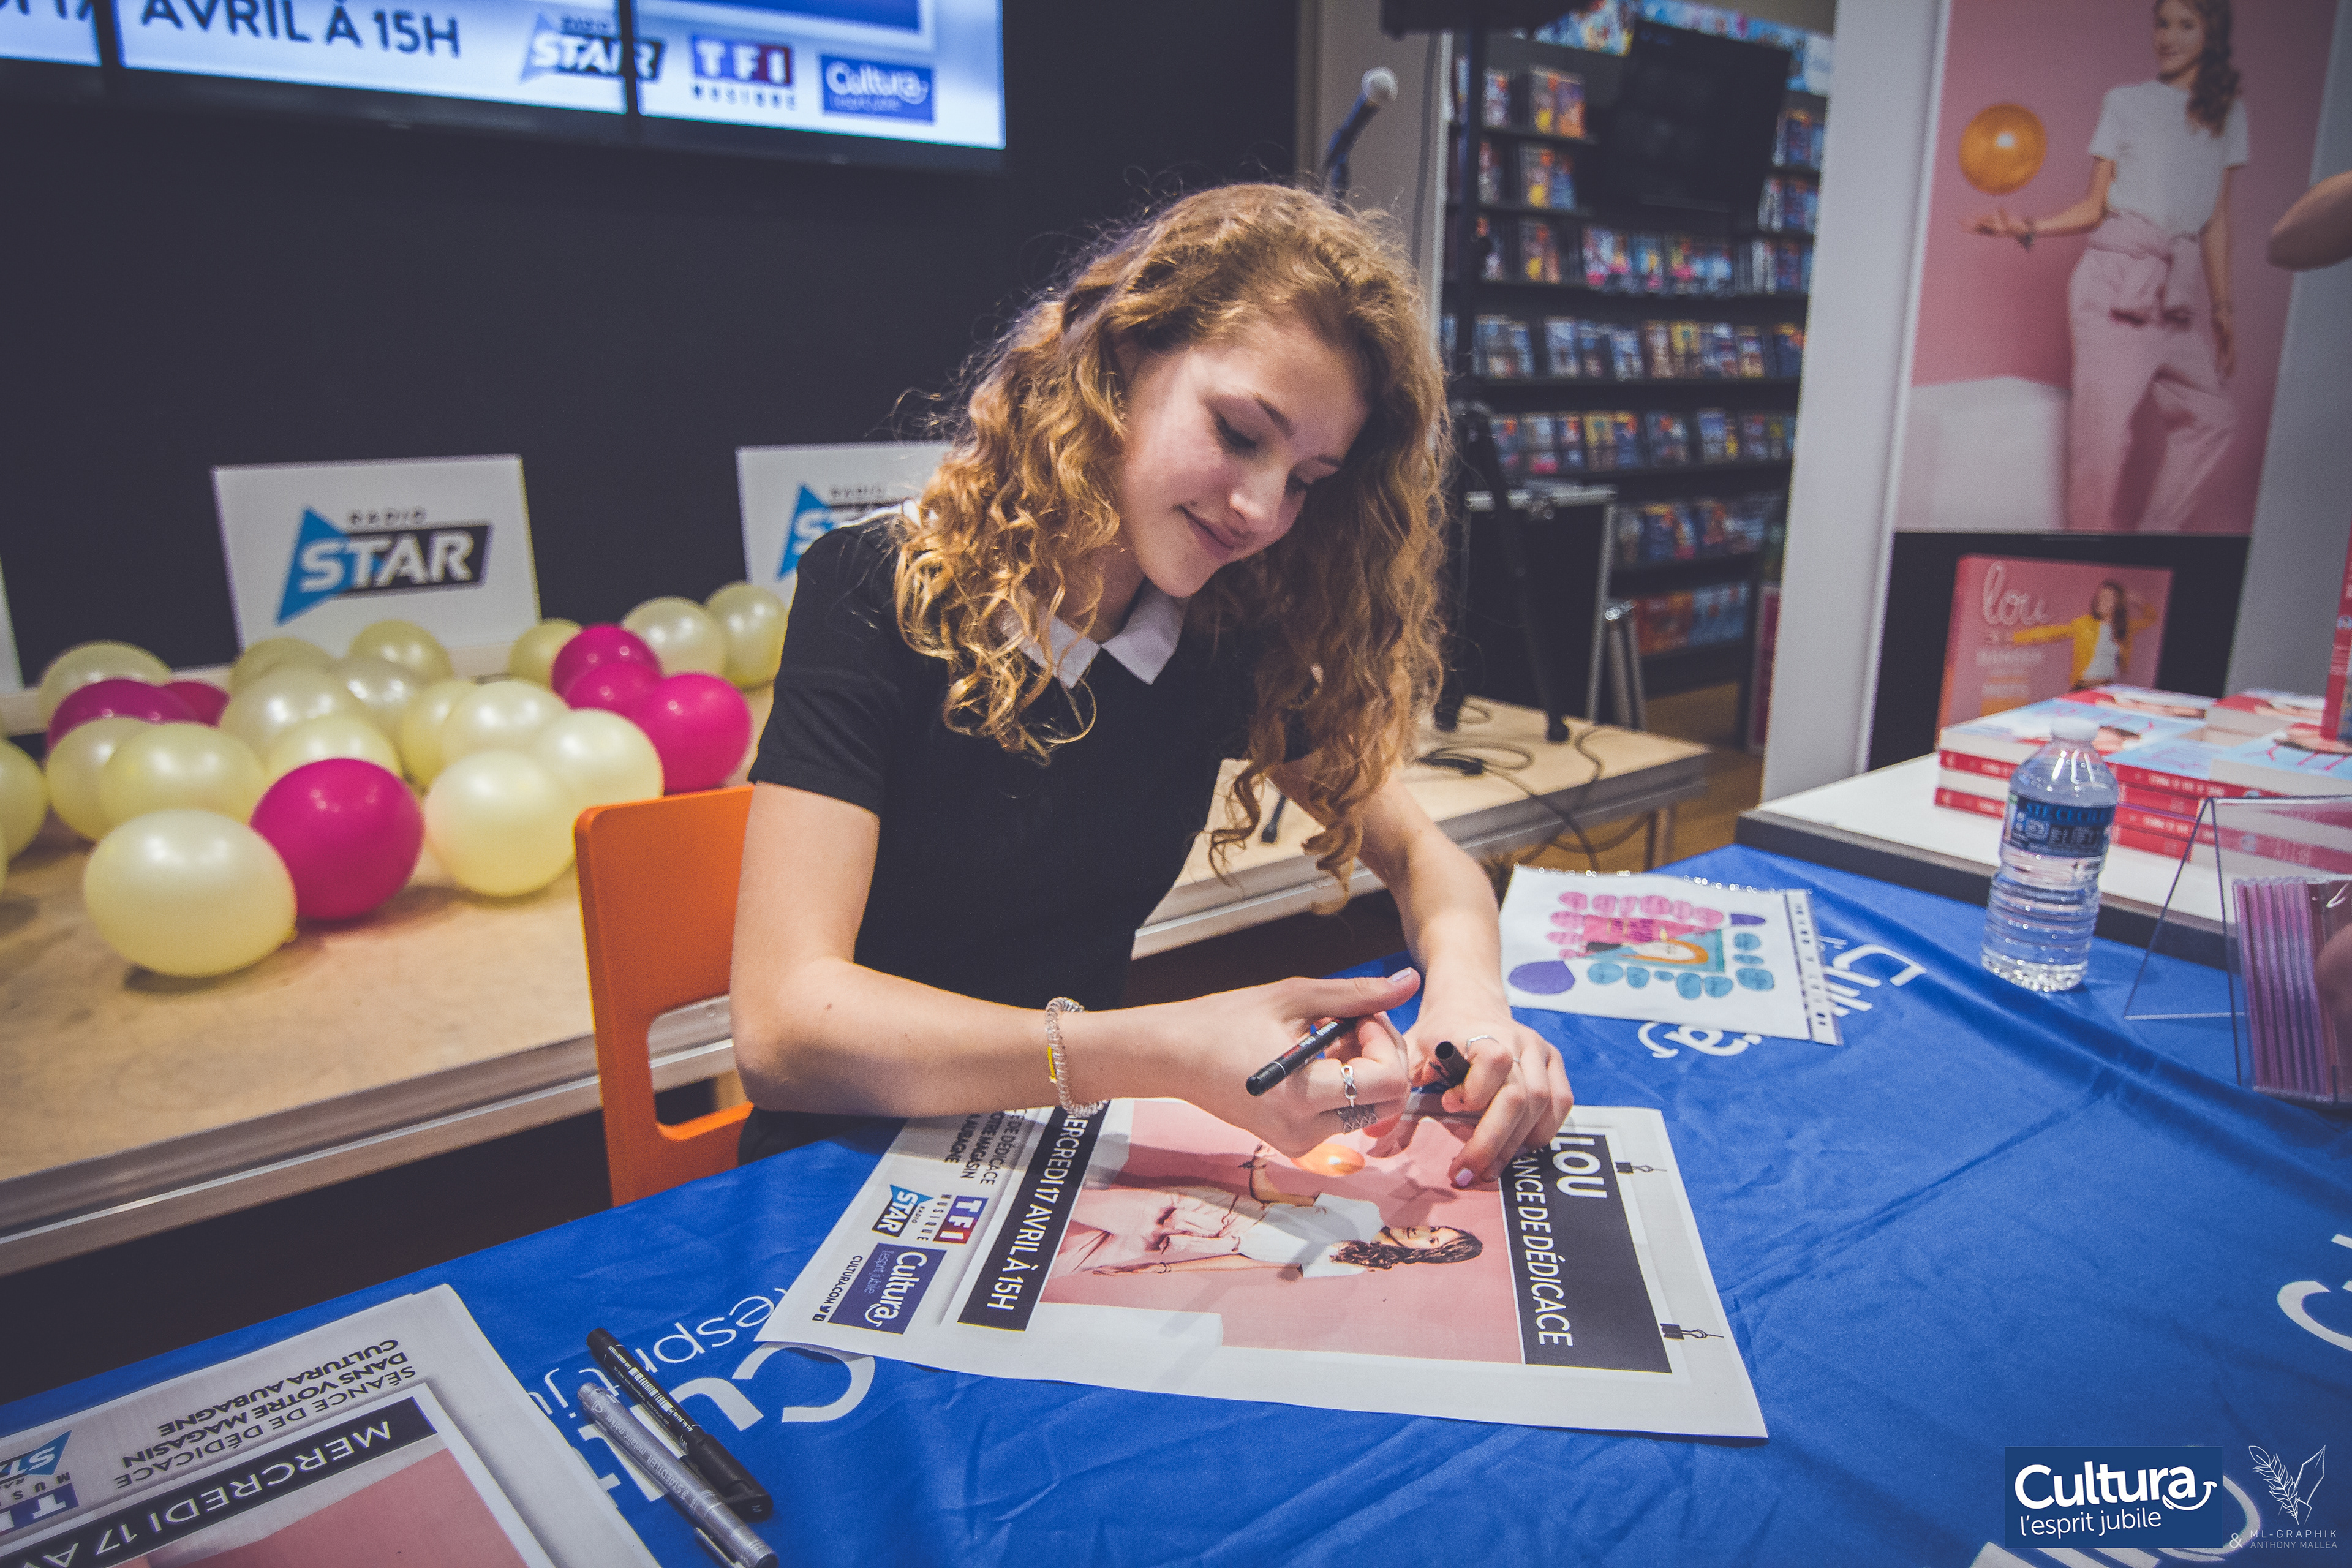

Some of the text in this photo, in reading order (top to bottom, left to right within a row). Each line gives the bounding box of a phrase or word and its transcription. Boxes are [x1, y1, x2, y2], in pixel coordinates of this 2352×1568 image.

[140, 0, 311, 43] AVRIL
[372, 10, 461, 58] 15H
[825, 60, 929, 104] Cultura
[300, 529, 475, 593] STAR
[1550, 1136, 1608, 1199] LOU
[876, 1191, 919, 1233] STAR
[911, 1205, 925, 1224] RADIO
[916, 1194, 952, 1242] MUSIQUE
[987, 1115, 1088, 1310] ERCREDI 17 AVRIL À 15H
[1518, 1206, 1551, 1234] DE
[867, 1251, 928, 1323] Cultura
[1523, 1234, 1574, 1347] DÉDICACE
[122, 1352, 409, 1468] DANS VOTRE MAGASIN
[157, 1340, 399, 1437] CULTURA AUBAGNE
[114, 1366, 417, 1490] SÉANCE DE DÉDICACE
[605, 1414, 685, 1494] STAEDTLER metallic marker
[148, 1420, 391, 1532] MERCREDI
[96, 1523, 138, 1556] 17
